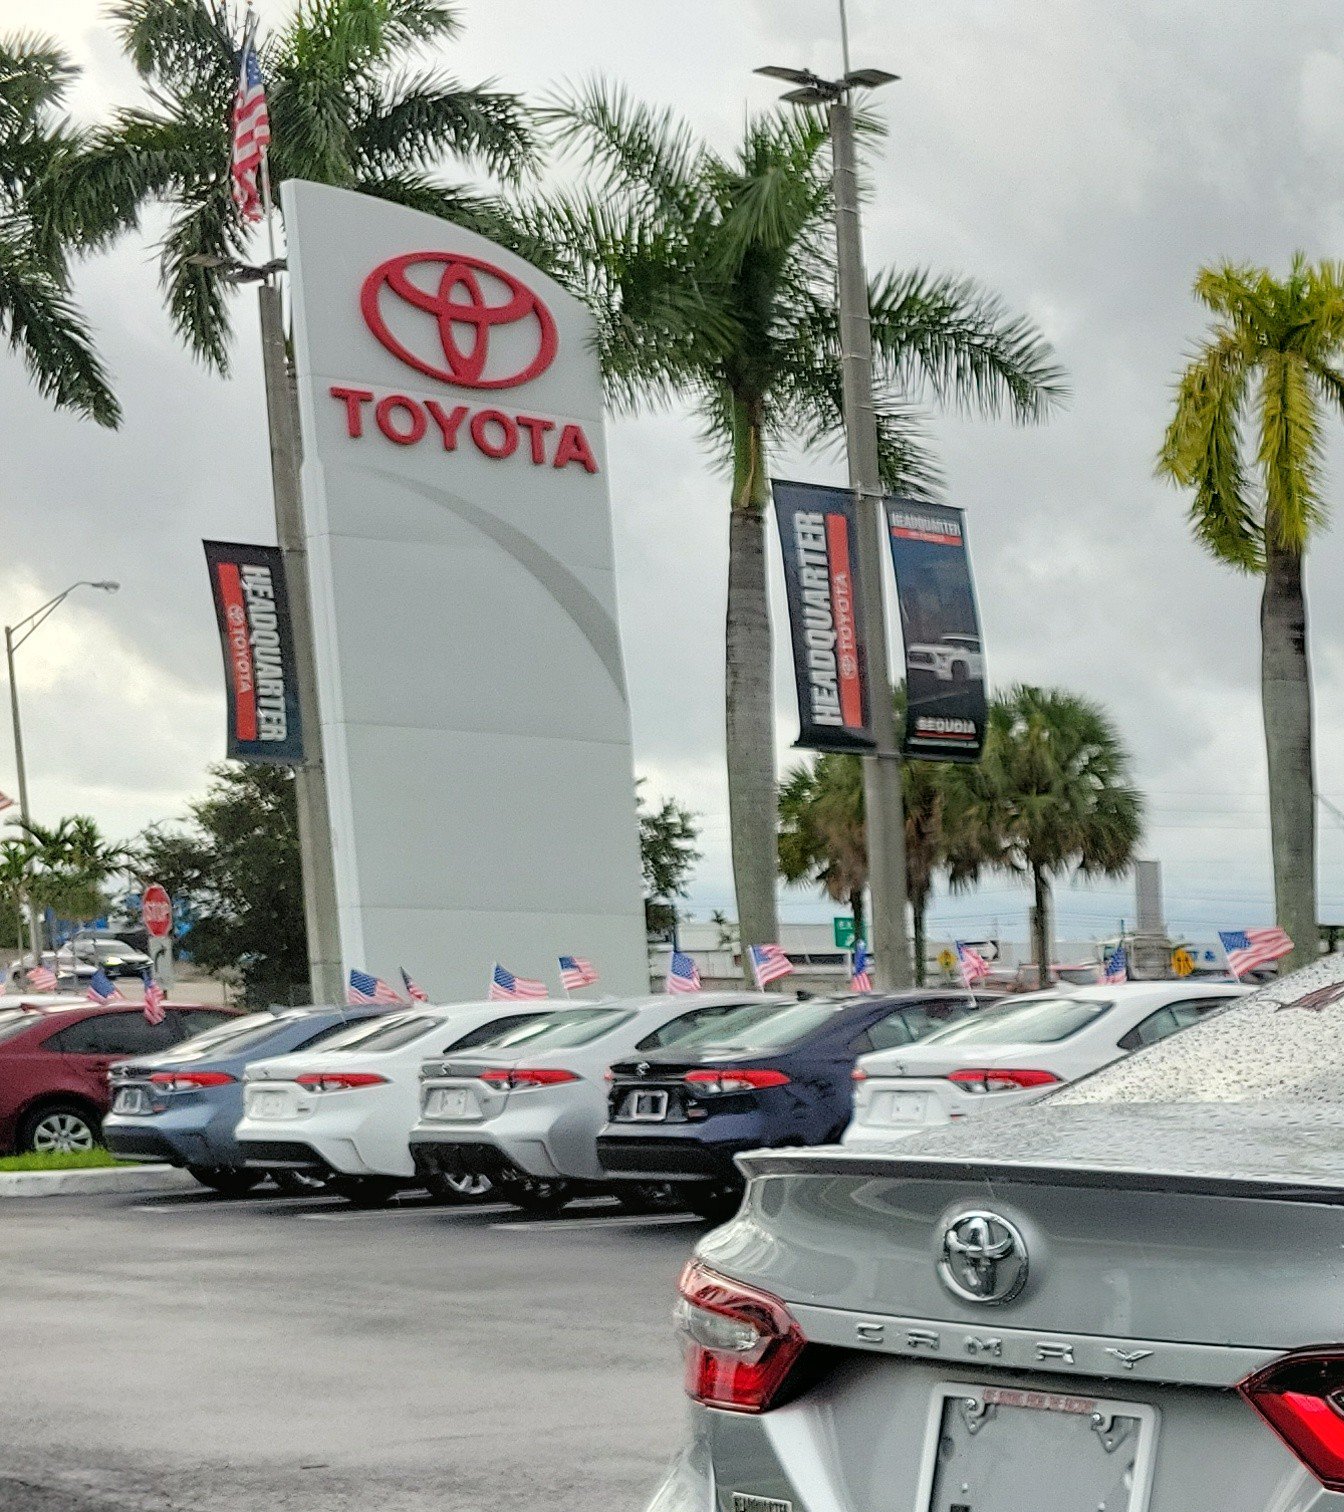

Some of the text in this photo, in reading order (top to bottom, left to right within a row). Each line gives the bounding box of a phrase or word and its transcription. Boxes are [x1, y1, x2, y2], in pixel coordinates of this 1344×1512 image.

[330, 386, 599, 474] TOYOTA
[241, 565, 287, 741] HEADQUARTER
[795, 511, 844, 726] HEADQUARTER
[833, 573, 855, 652] TOYOTA
[231, 624, 252, 694] TOYOTA
[856, 1322, 1154, 1369] CAMRY
